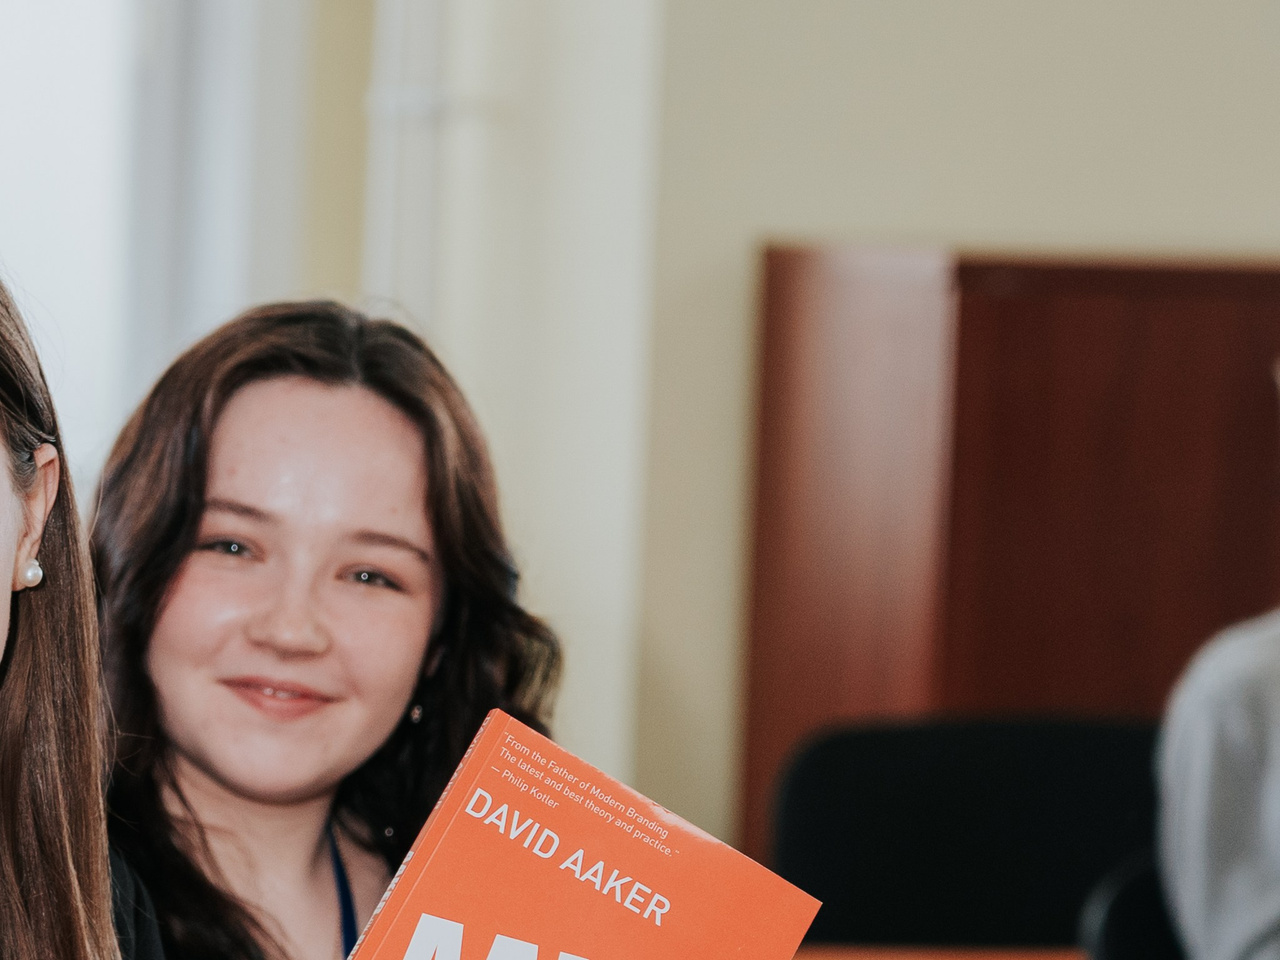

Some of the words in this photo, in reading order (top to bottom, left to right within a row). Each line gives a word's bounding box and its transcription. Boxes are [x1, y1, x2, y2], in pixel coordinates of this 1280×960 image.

[500, 746, 518, 764] The
[519, 758, 545, 781] latest
[544, 774, 562, 792] and
[563, 785, 584, 804] best
[584, 798, 615, 824] theory
[614, 818, 634, 835] and
[502, 770, 529, 792] Philip
[530, 787, 559, 809] Kotler
[504, 731, 531, 756] “From
[531, 749, 548, 767] the
[547, 759, 579, 789] Father
[579, 779, 591, 791] of
[590, 785, 625, 813] Modern
[626, 807, 669, 839] Branding
[465, 787, 560, 859] DAVID
[559, 849, 671, 926] AAKER
